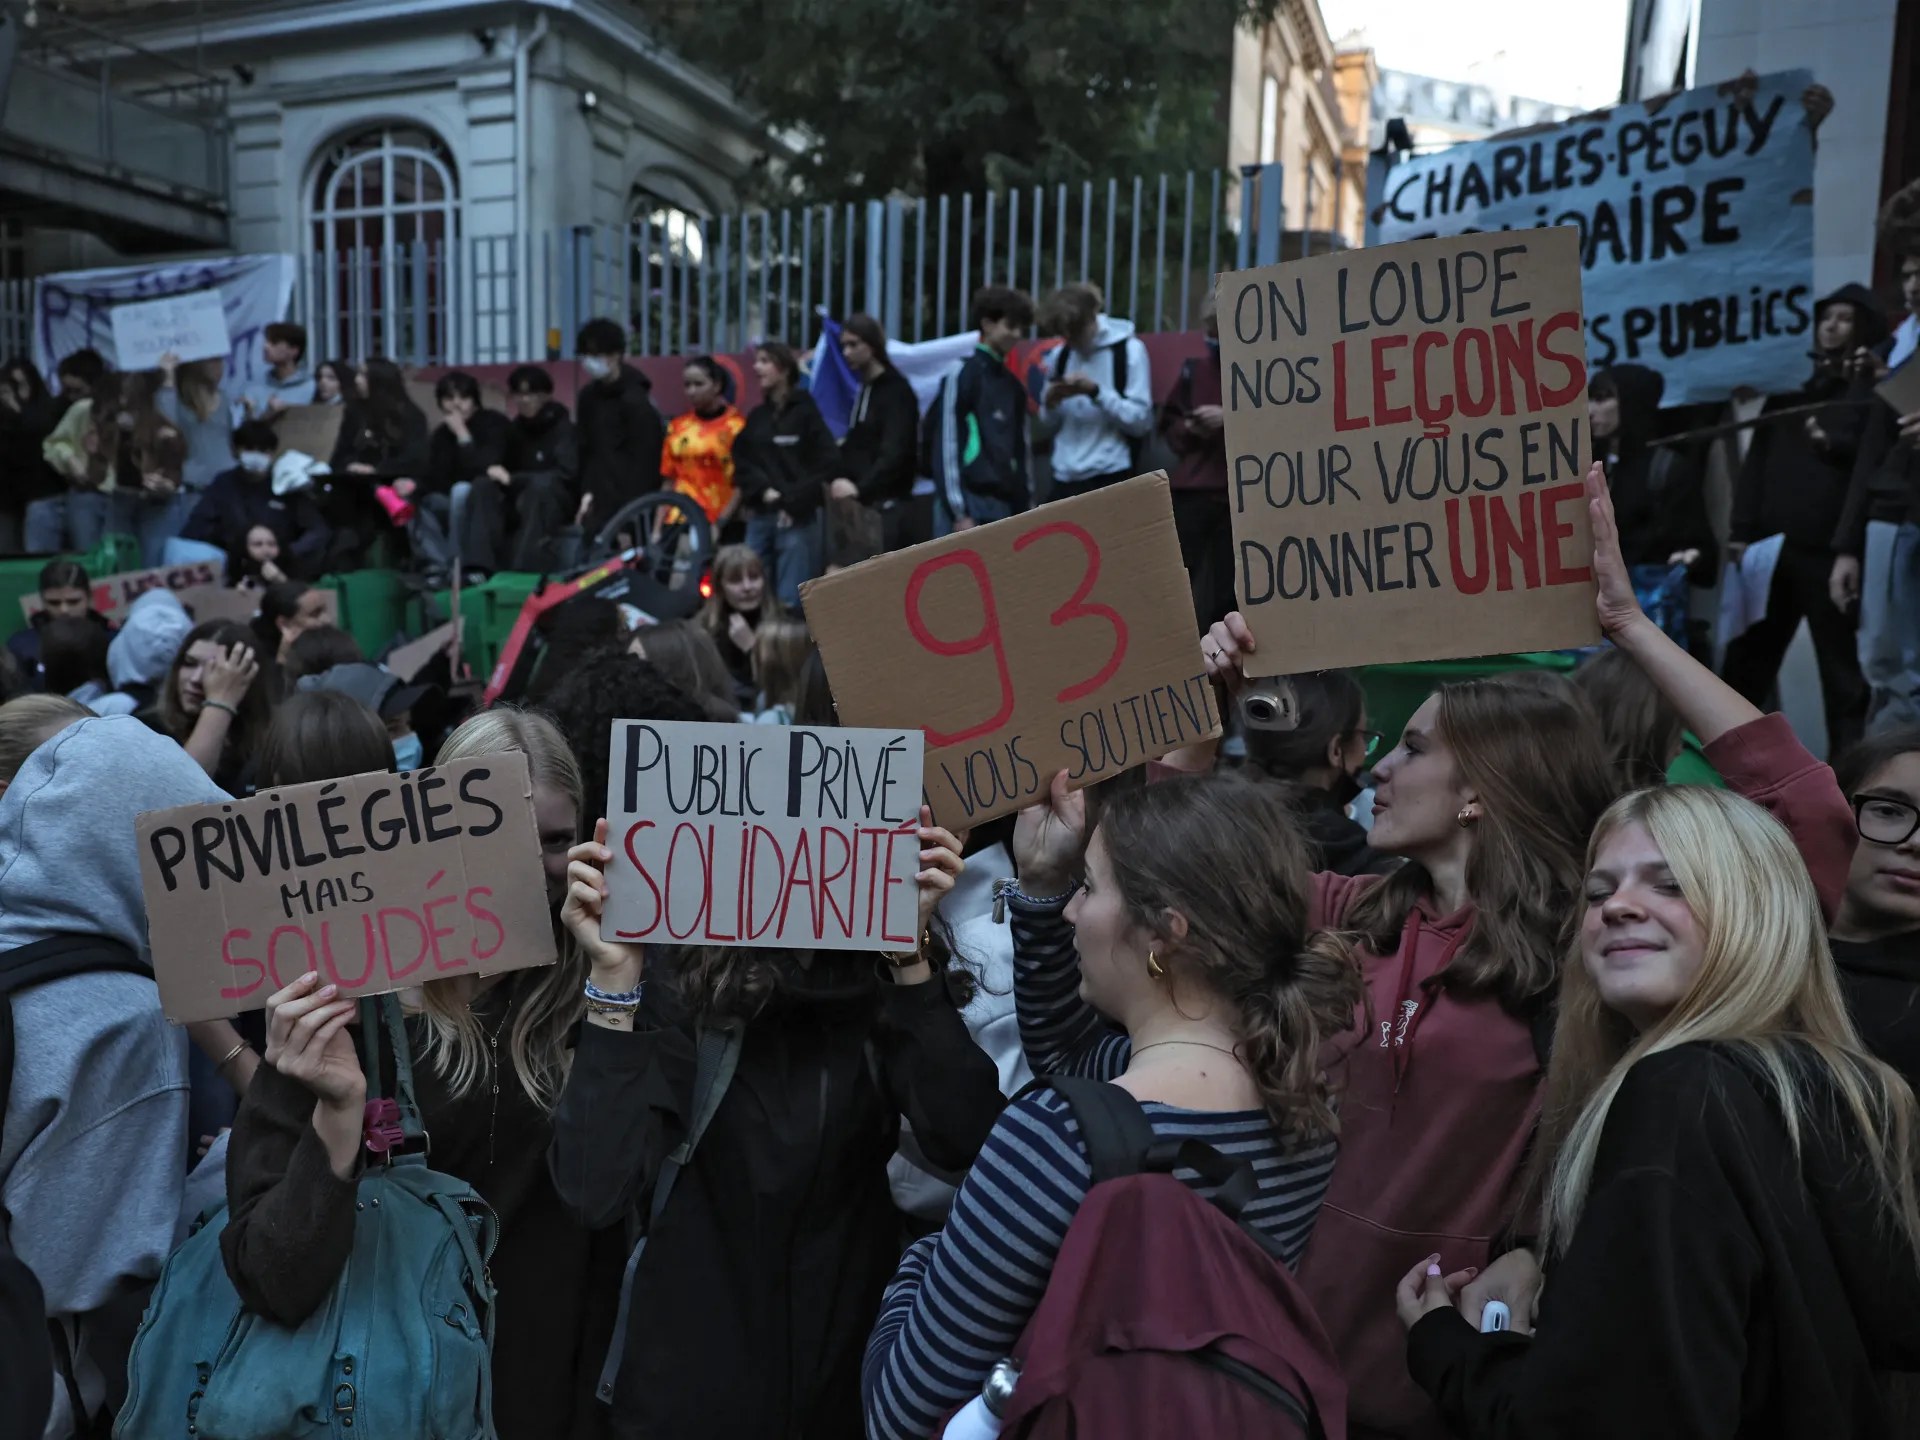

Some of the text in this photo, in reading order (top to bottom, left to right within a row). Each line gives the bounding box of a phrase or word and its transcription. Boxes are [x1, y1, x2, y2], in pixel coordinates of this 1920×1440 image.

[1234, 245, 1531, 344] ON LOUPE
[1622, 285, 1811, 358] PUBLiCS
[1230, 311, 1586, 439] NOS LEÇONS
[1235, 418, 1580, 513] POUR VOUS EN
[1240, 483, 1591, 605] DONNER UNE
[905, 521, 1128, 748] 93
[623, 724, 765, 816] PUBLiC
[786, 730, 907, 823] PRiVÉ
[940, 736, 1039, 818] VOUS
[1060, 673, 1213, 780] SOUTIENT
[150, 767, 502, 891] PRiViLÉGiÉS
[615, 818, 918, 943] SOLiDARiTÉ
[220, 870, 505, 999] SOUDÉS
[280, 872, 374, 918] MAIS
